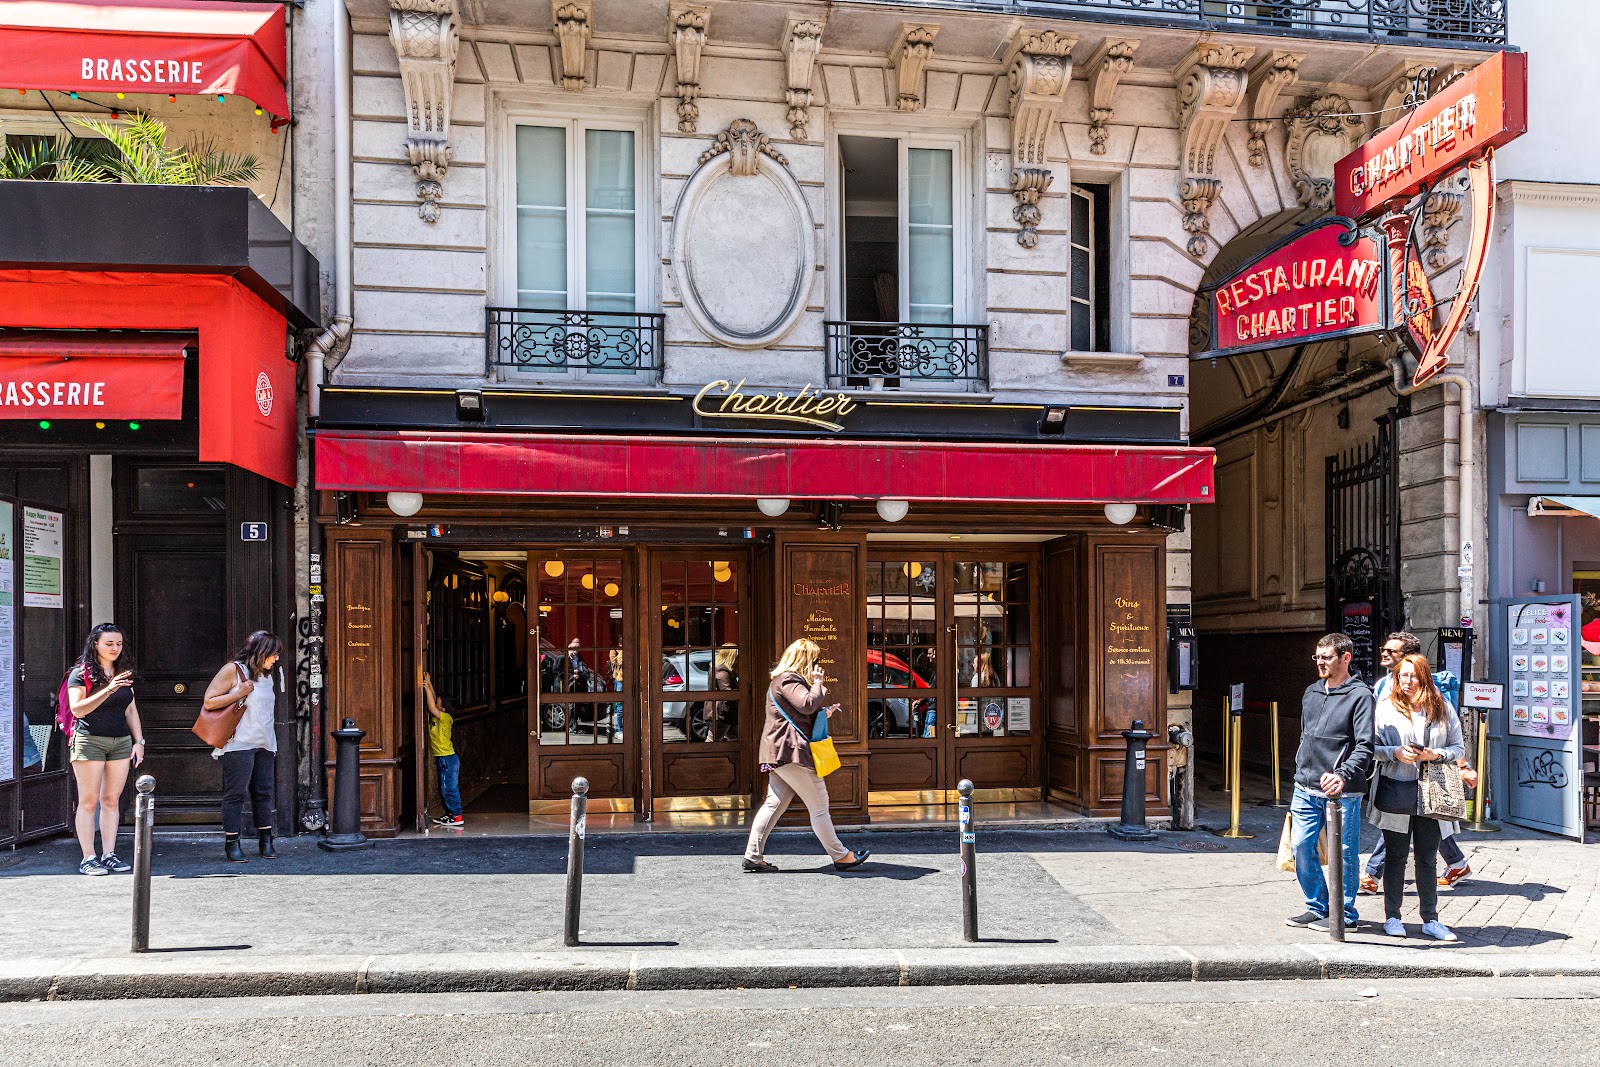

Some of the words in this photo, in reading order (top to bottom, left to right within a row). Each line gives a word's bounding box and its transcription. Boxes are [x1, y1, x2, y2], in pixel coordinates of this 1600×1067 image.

[81, 57, 203, 83] BRASSERIE
[1350, 93, 1477, 197] CHARTIER
[1215, 257, 1382, 316] RESTAURANT
[1236, 295, 1356, 341] CHARTIER
[0, 381, 106, 407] ASSERIE
[692, 376, 858, 432] Chartier
[249, 525, 259, 539] 5
[1115, 597, 1140, 608] Vins
[806, 613, 834, 622] Maison
[803, 624, 837, 632] Familiale
[1109, 621, 1150, 635] Spiritueux
[1178, 627, 1196, 637] MENU
[1440, 628, 1464, 638] MENU
